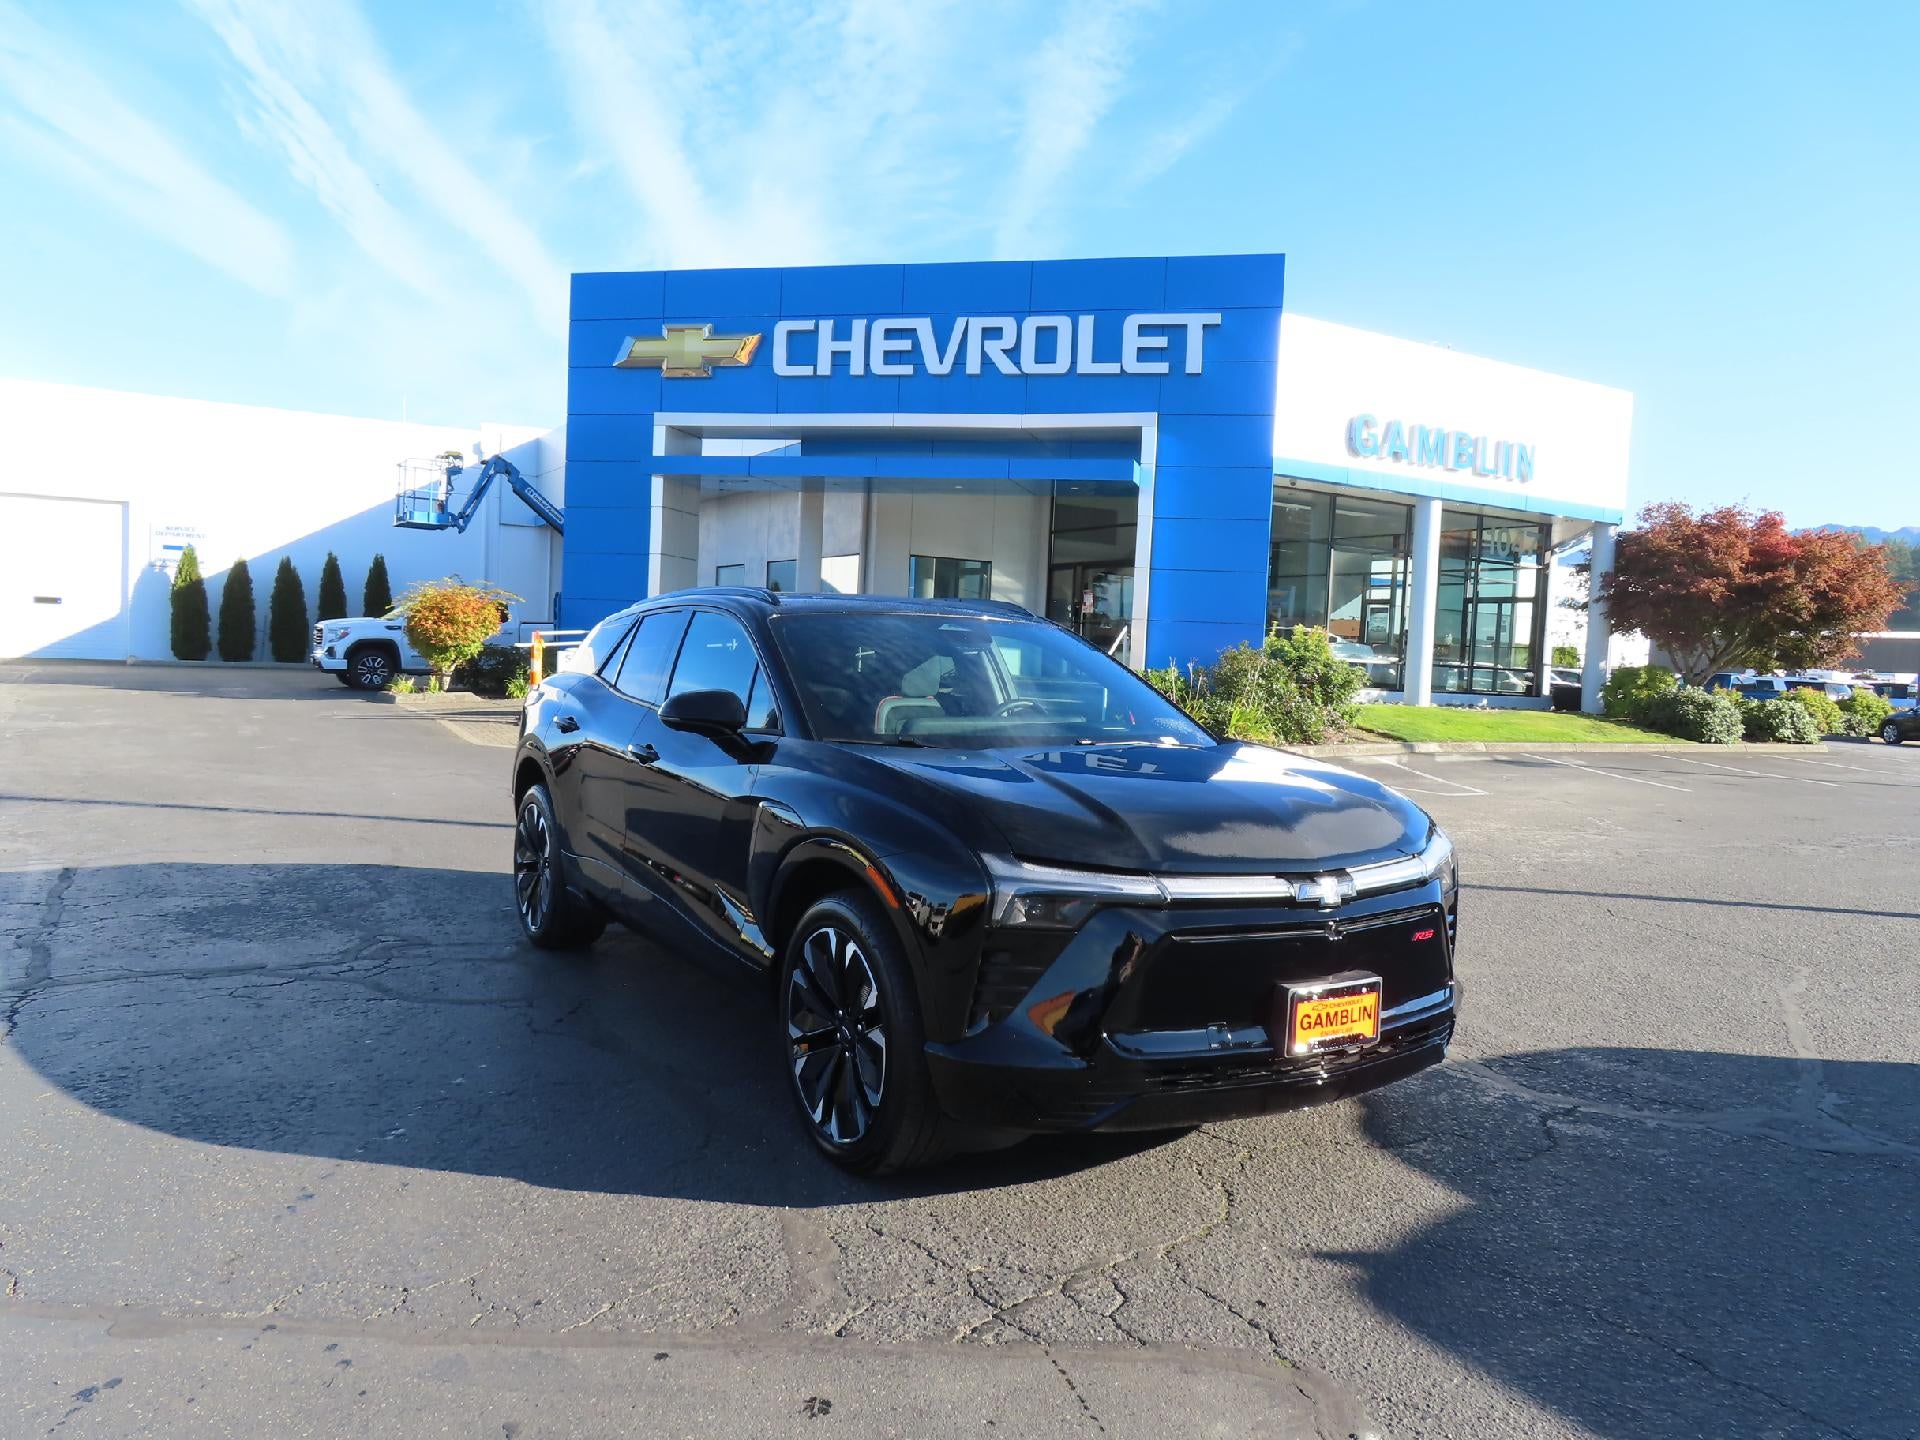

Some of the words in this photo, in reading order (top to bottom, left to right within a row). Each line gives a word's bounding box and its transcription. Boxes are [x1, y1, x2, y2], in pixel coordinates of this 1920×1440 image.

[772, 312, 1222, 377] CHEVROLET
[1346, 412, 1536, 483] GAMBLIN
[1412, 929, 1435, 941] RS
[1300, 1004, 1373, 1031] GAMBLIN
